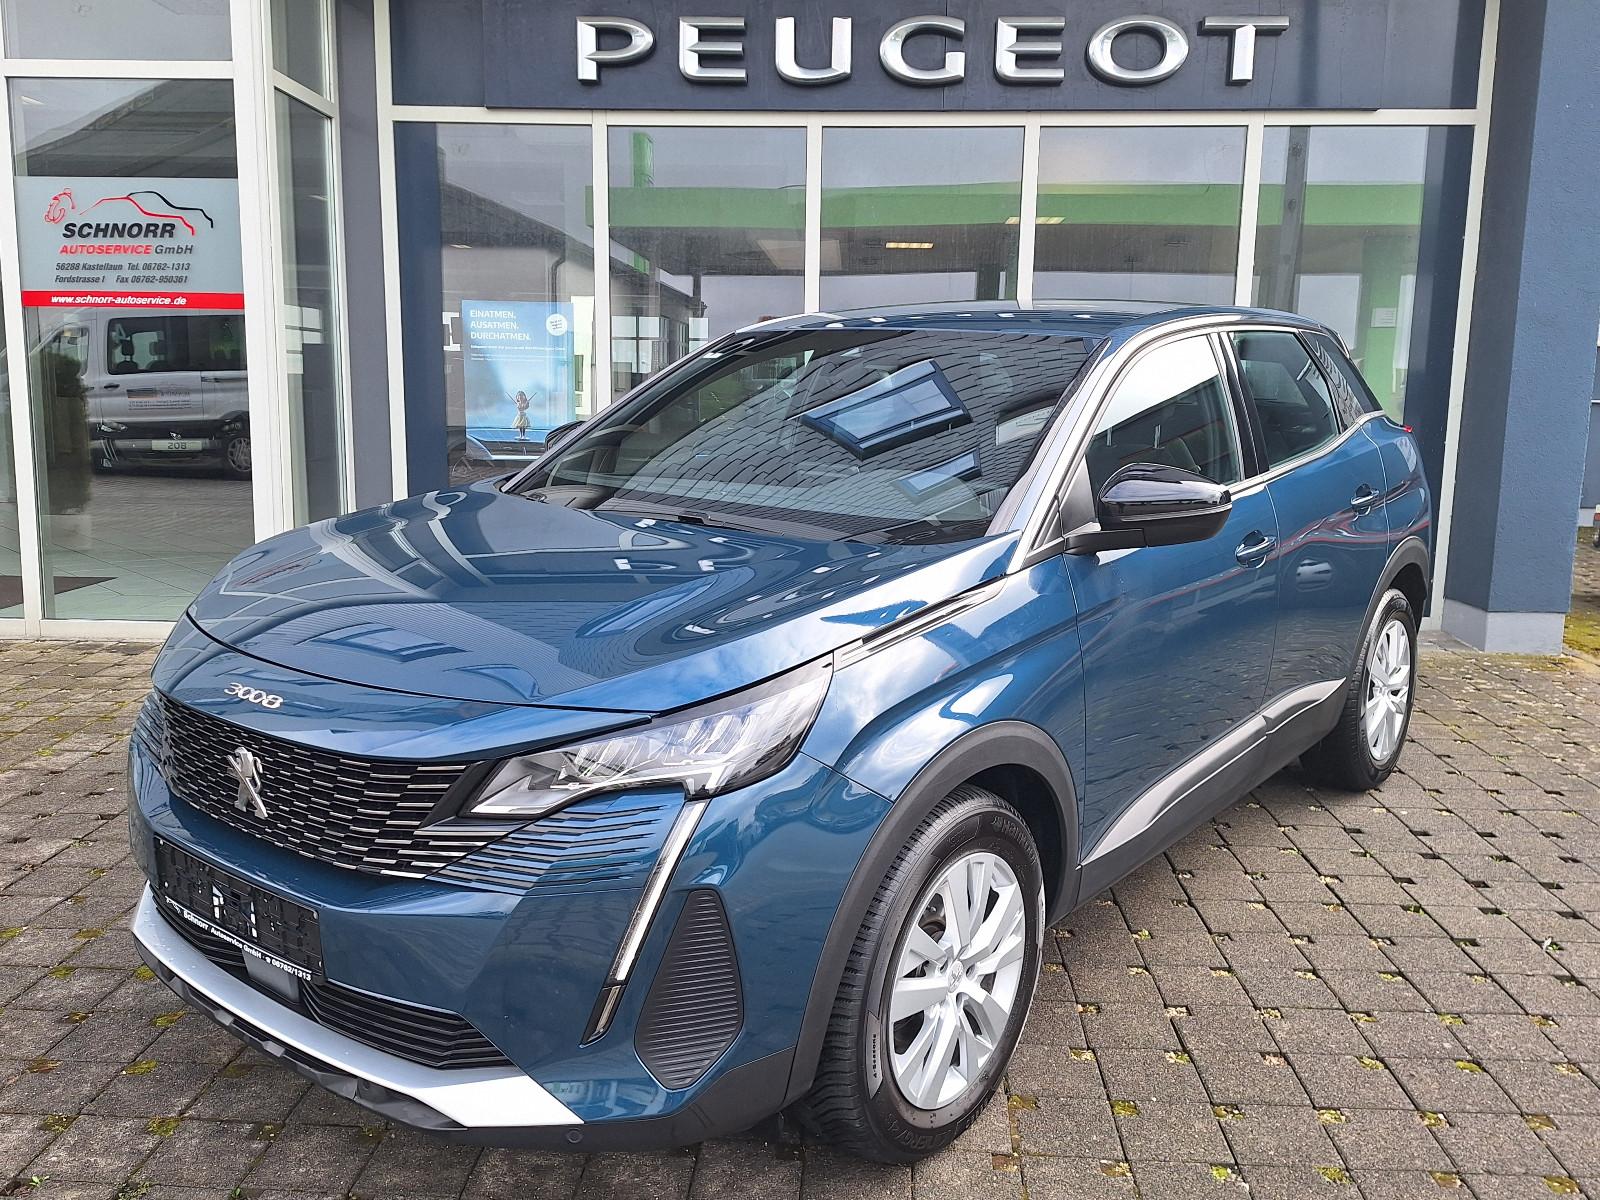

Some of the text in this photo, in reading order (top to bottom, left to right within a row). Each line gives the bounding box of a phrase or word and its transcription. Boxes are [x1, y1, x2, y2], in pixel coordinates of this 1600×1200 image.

[576, 15, 1290, 84] PEUGEOT
[62, 222, 176, 239] SCHNORR
[59, 244, 194, 255] AUTOSERVICE GmbH
[55, 262, 191, 272] 56288 Kastellaun Tel. 06762-1313
[54, 276, 99, 284] Fordstrasse
[116, 276, 129, 284] Fax
[131, 276, 188, 285] 06762-950361
[51, 295, 187, 306] www.schnorr-autoservice.de
[470, 310, 517, 319] EINATMEN.
[470, 321, 519, 330] AUSATMEN.
[470, 332, 531, 340] DURCHATMEN.
[224, 683, 284, 709] 3008
[183, 910, 209, 930] Schnorr
[243, 944, 262, 960] GmbH
[271, 958, 312, 981] 06762/1313
